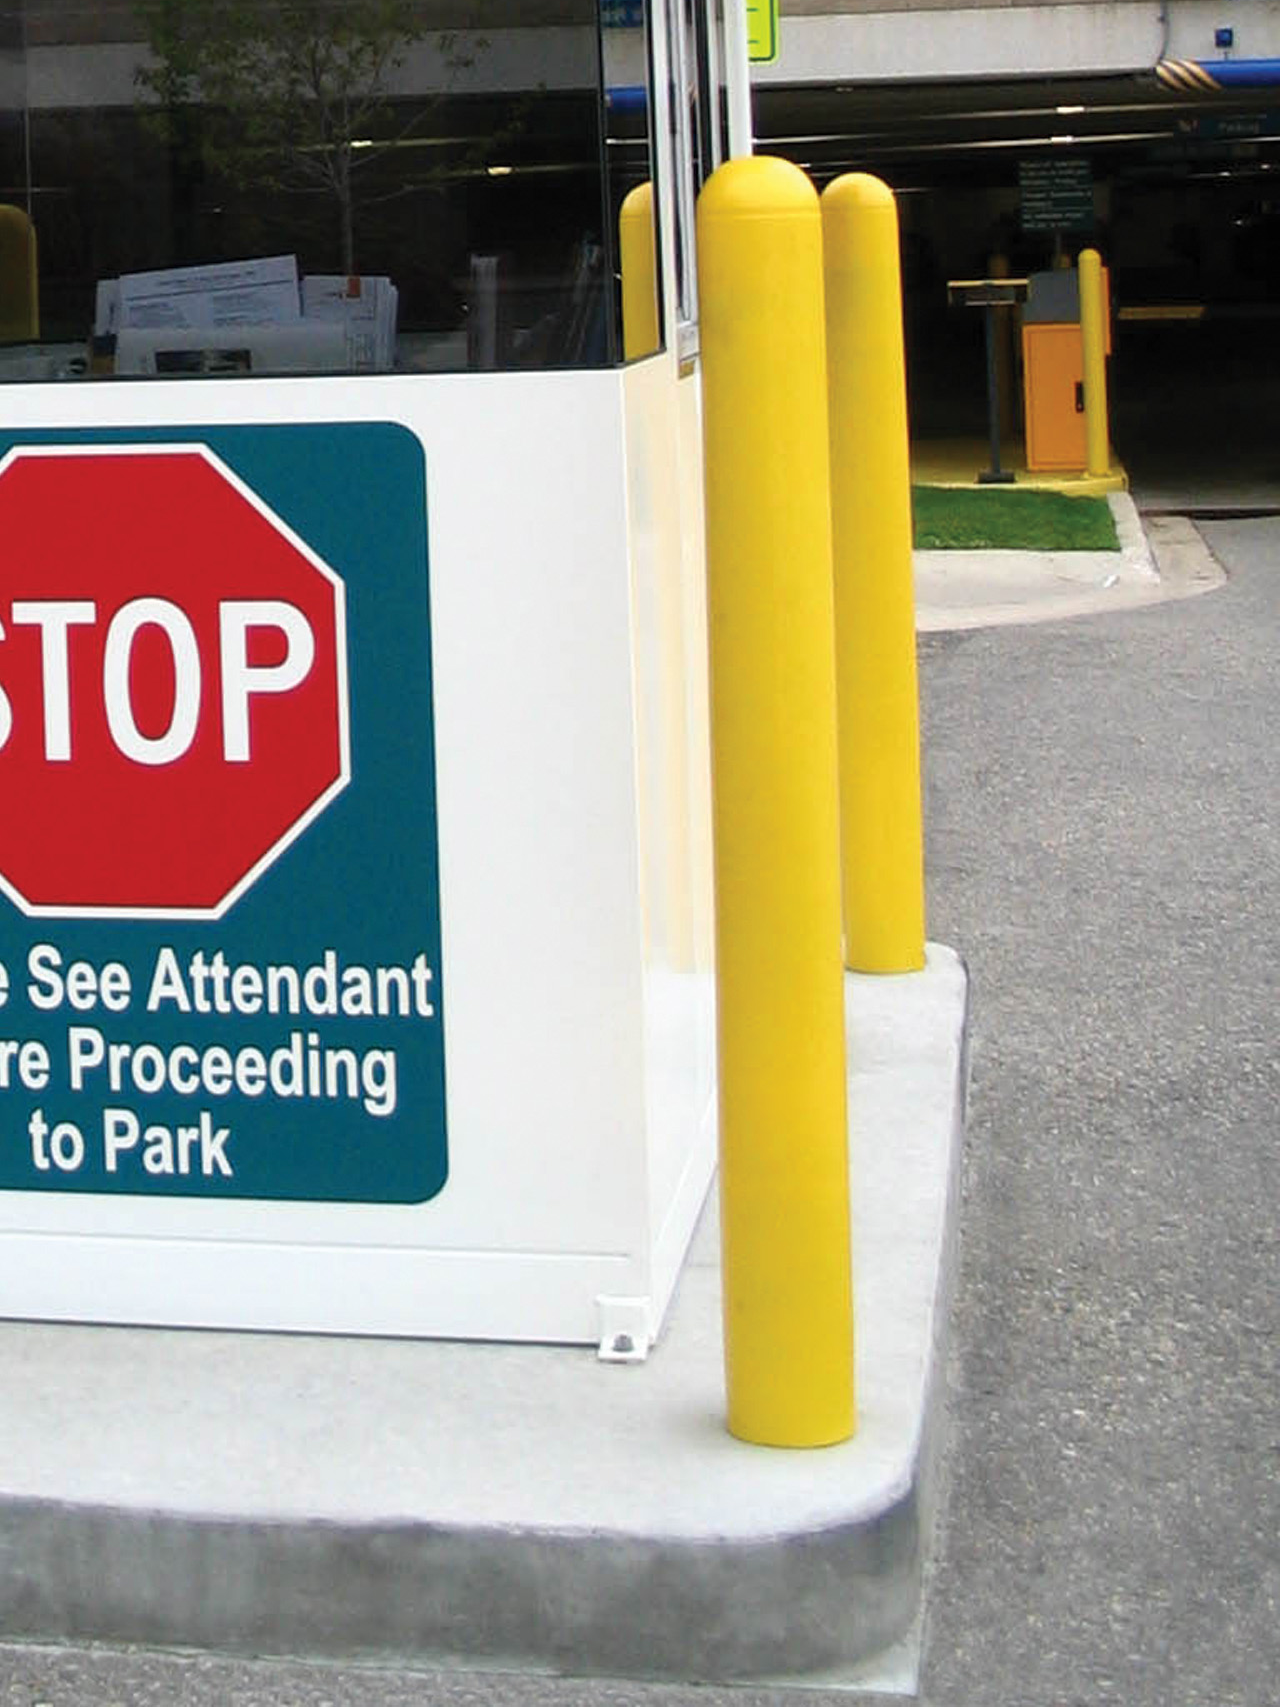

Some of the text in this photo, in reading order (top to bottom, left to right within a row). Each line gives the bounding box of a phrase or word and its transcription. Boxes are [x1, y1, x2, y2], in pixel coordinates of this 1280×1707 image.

[27, 943, 132, 1012] See
[146, 947, 435, 1018] Attendant
[68, 1026, 398, 1117] Proceeding
[27, 1108, 234, 1177] to Park
